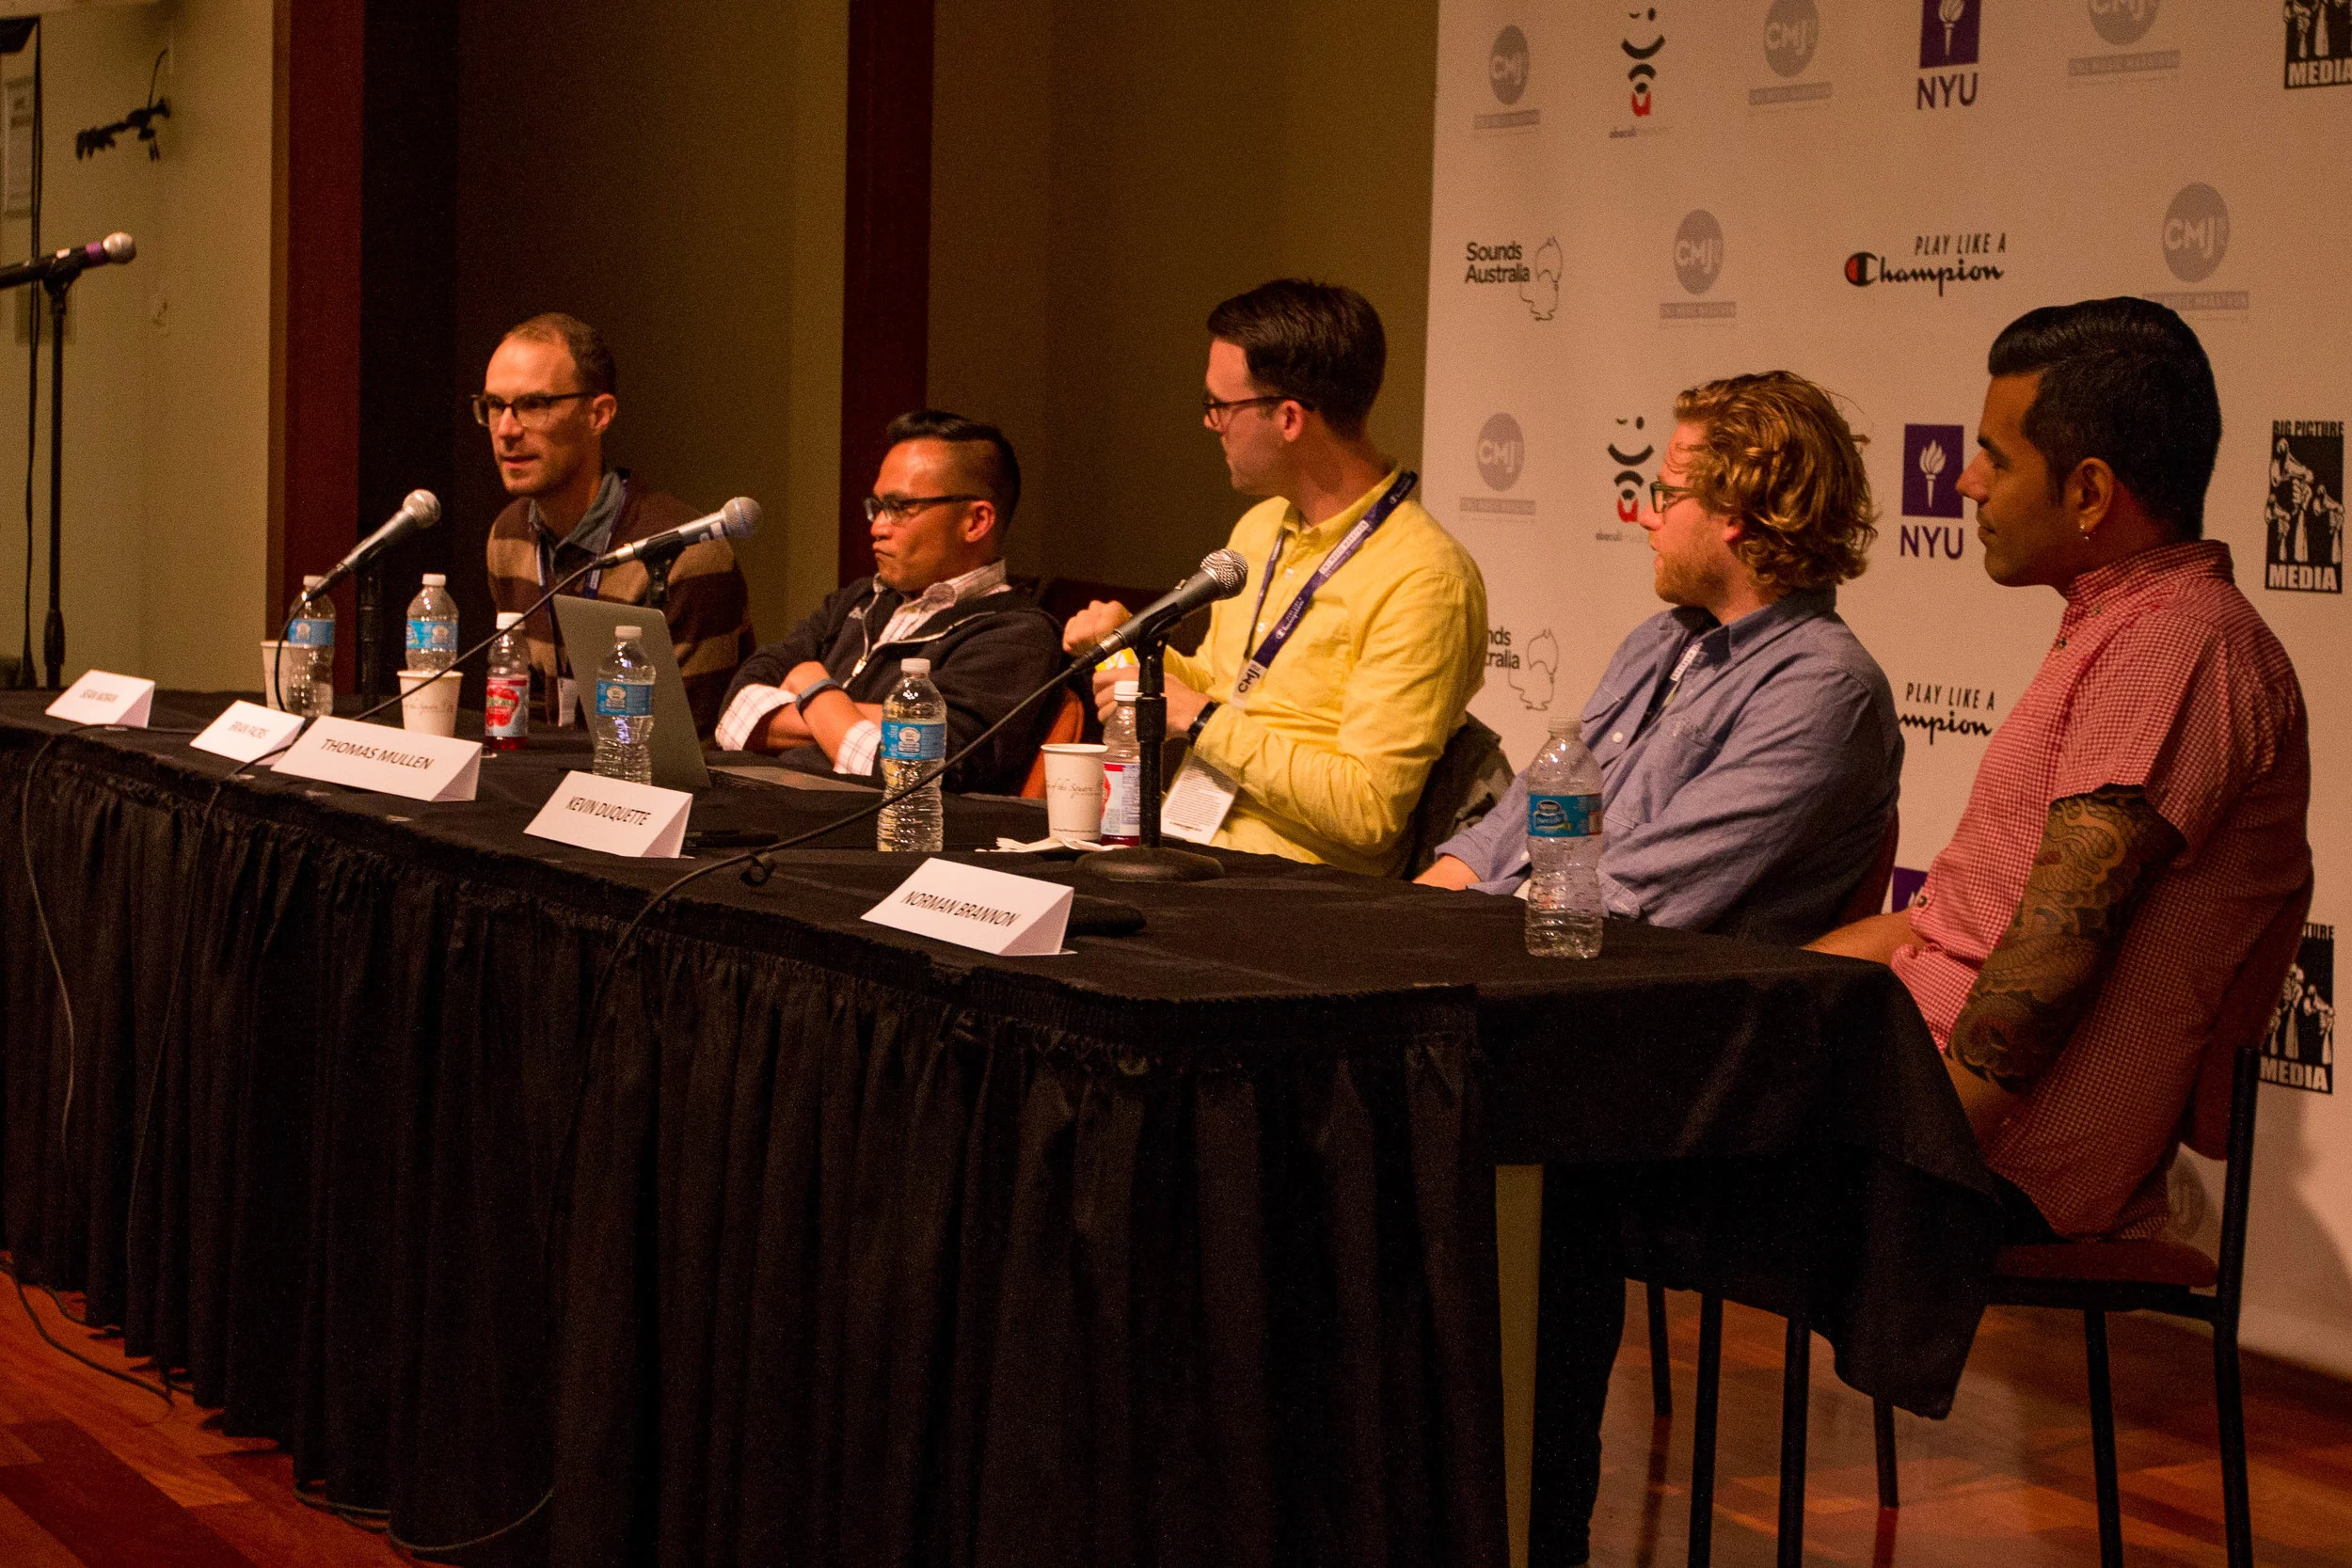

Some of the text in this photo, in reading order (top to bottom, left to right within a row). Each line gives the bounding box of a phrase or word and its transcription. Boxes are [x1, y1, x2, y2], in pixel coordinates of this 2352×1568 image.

[1916, 71, 1979, 110] NYU
[1466, 240, 1522, 261] Sounds
[1915, 232, 2007, 256] PLAY LIKE A
[2165, 217, 2216, 259] CMJ
[1675, 238, 1715, 274] CMJ
[1464, 262, 1531, 284] Australia
[1844, 251, 2005, 297] Champion
[2273, 420, 2344, 437] BIG PICTURE
[1900, 524, 1964, 560] NYU
[2268, 564, 2339, 592] MEDIA
[1487, 626, 1511, 646] nds
[1486, 649, 1520, 670] ralia
[1237, 668, 1260, 693] CMJ
[1905, 682, 1994, 711] PLAY LIKE A
[1899, 710, 1993, 746] mpion
[321, 738, 435, 770] THOMAS MULLEN
[565, 796, 652, 826] KEVIN DUQUETTE
[900, 891, 1023, 927] NORMAN BRANNON
[2305, 922, 2335, 941] TURE
[2260, 1054, 2328, 1091] MEDIA
